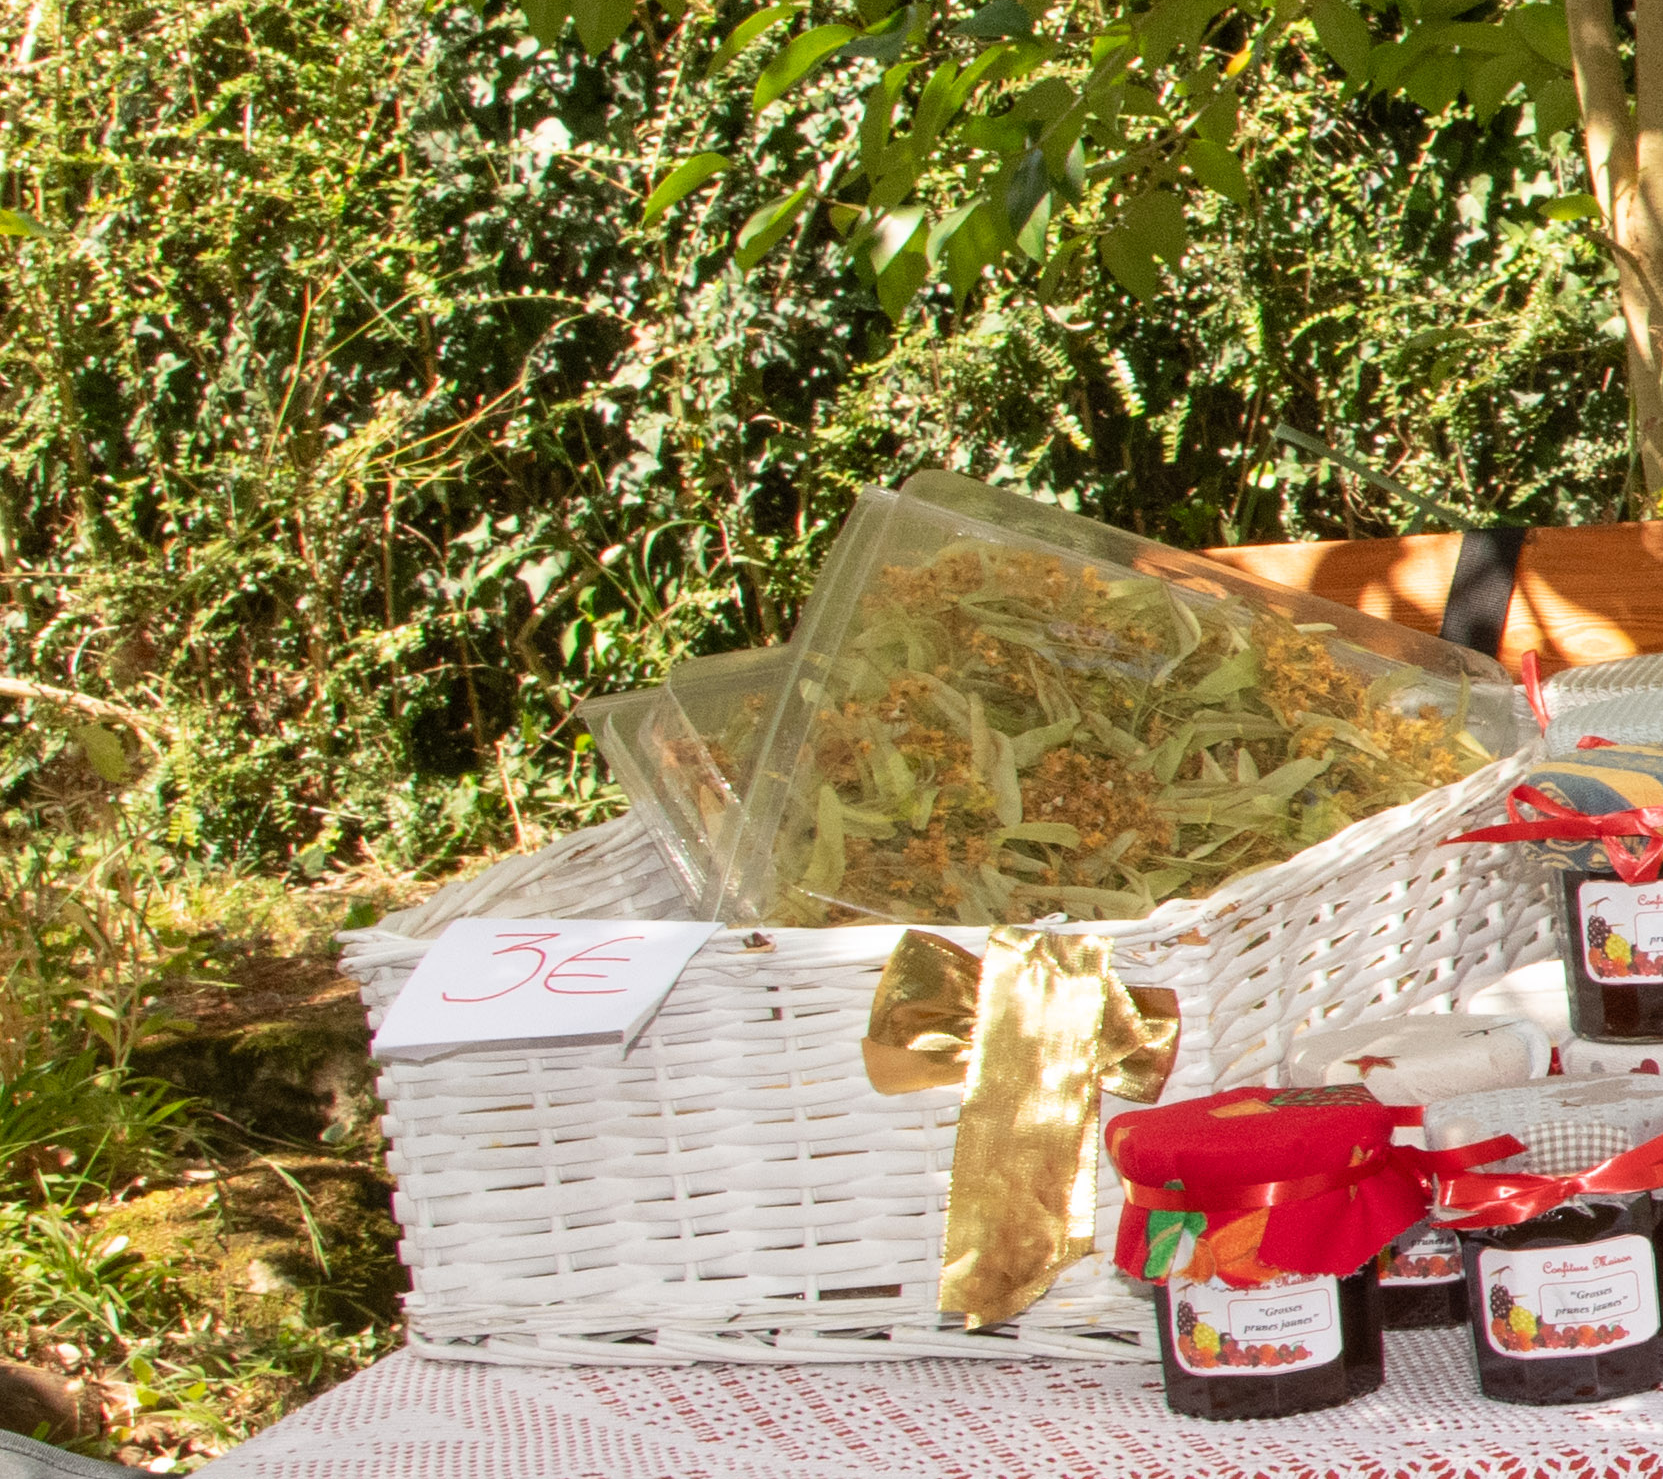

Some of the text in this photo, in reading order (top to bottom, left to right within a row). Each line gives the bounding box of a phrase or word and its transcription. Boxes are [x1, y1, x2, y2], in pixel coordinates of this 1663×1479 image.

[441, 932, 645, 1003] 3€
[1542, 1255, 1633, 1277] Confiture Maison
[1554, 1307, 1590, 1318] prunes
